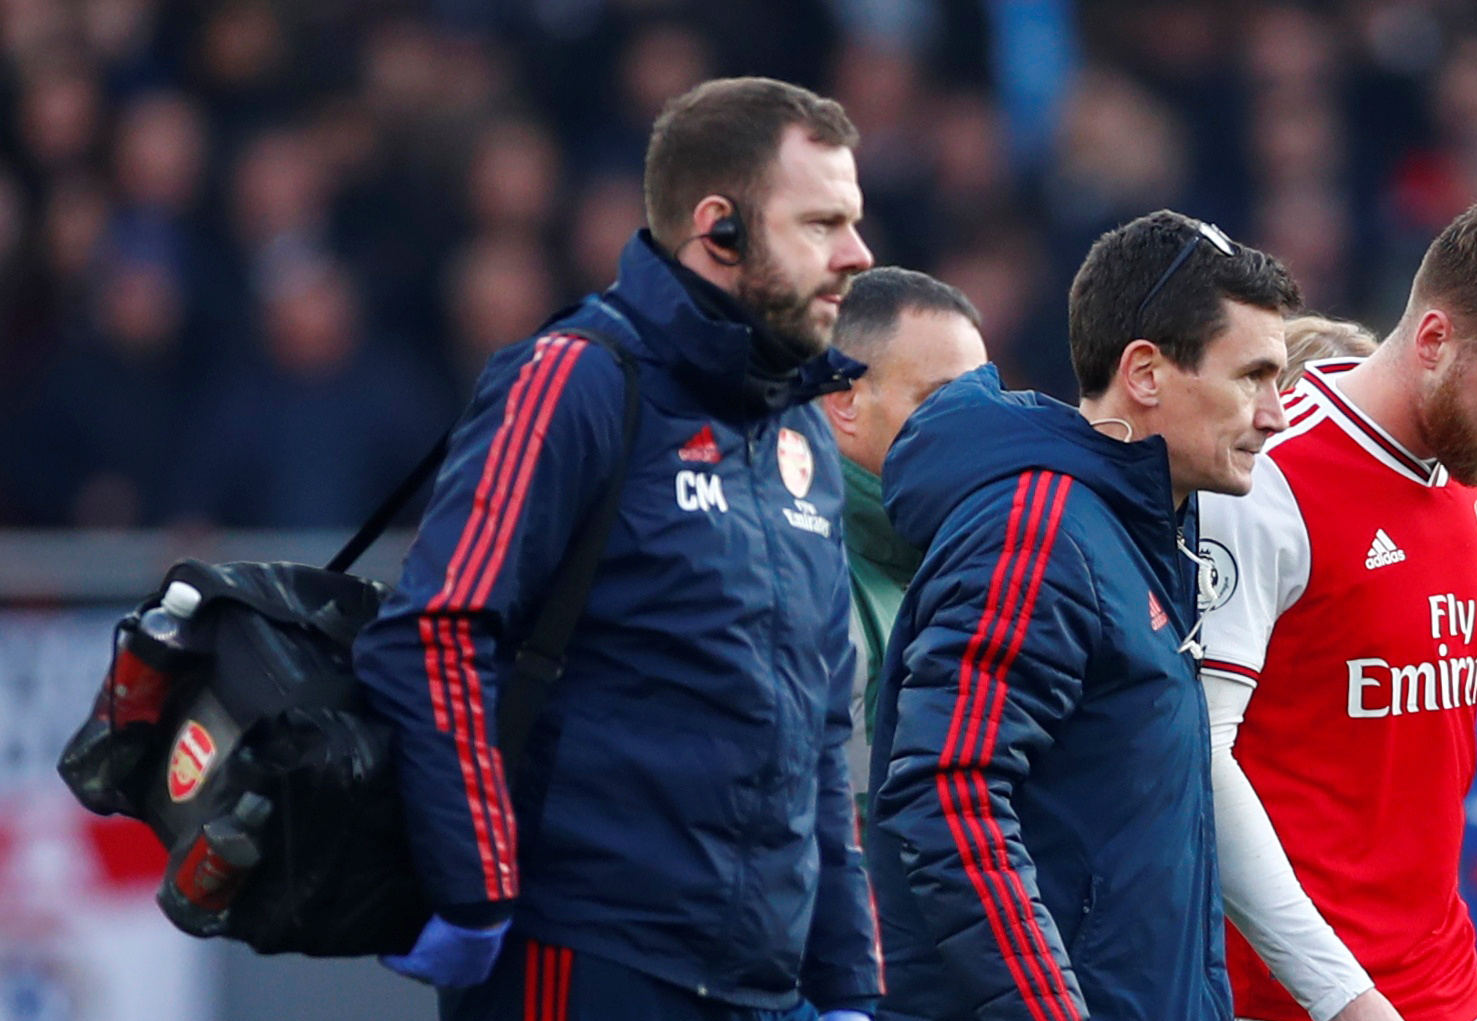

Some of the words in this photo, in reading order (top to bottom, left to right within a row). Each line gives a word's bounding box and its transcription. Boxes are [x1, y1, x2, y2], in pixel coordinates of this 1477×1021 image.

[676, 470, 729, 513] CM
[1365, 549, 1406, 570] adidas
[1428, 593, 1475, 645] Fly
